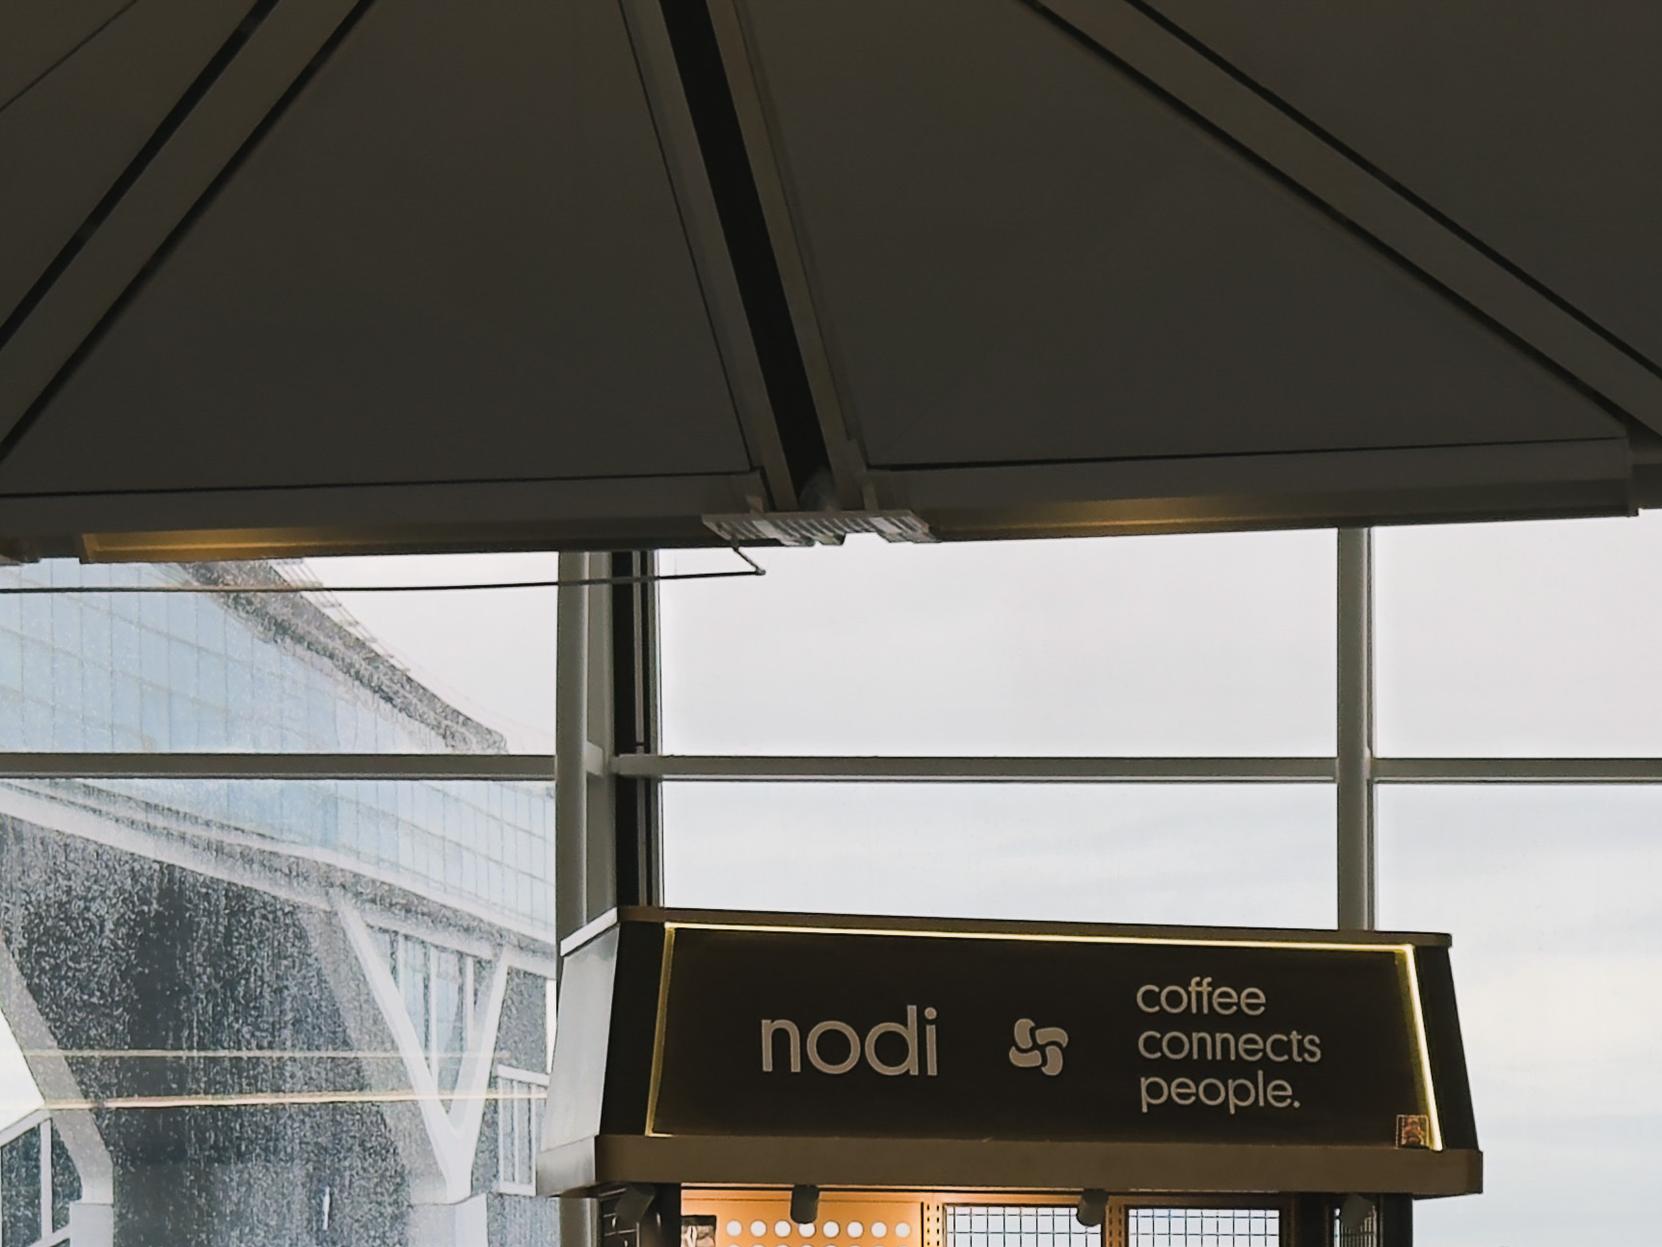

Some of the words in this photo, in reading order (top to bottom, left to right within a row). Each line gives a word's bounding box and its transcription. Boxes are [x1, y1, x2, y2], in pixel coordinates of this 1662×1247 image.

[1136, 976, 1266, 1016] coffee
[761, 1005, 938, 1076] nodi
[1137, 1026, 1322, 1063] connects
[1140, 1070, 1301, 1114] people.
